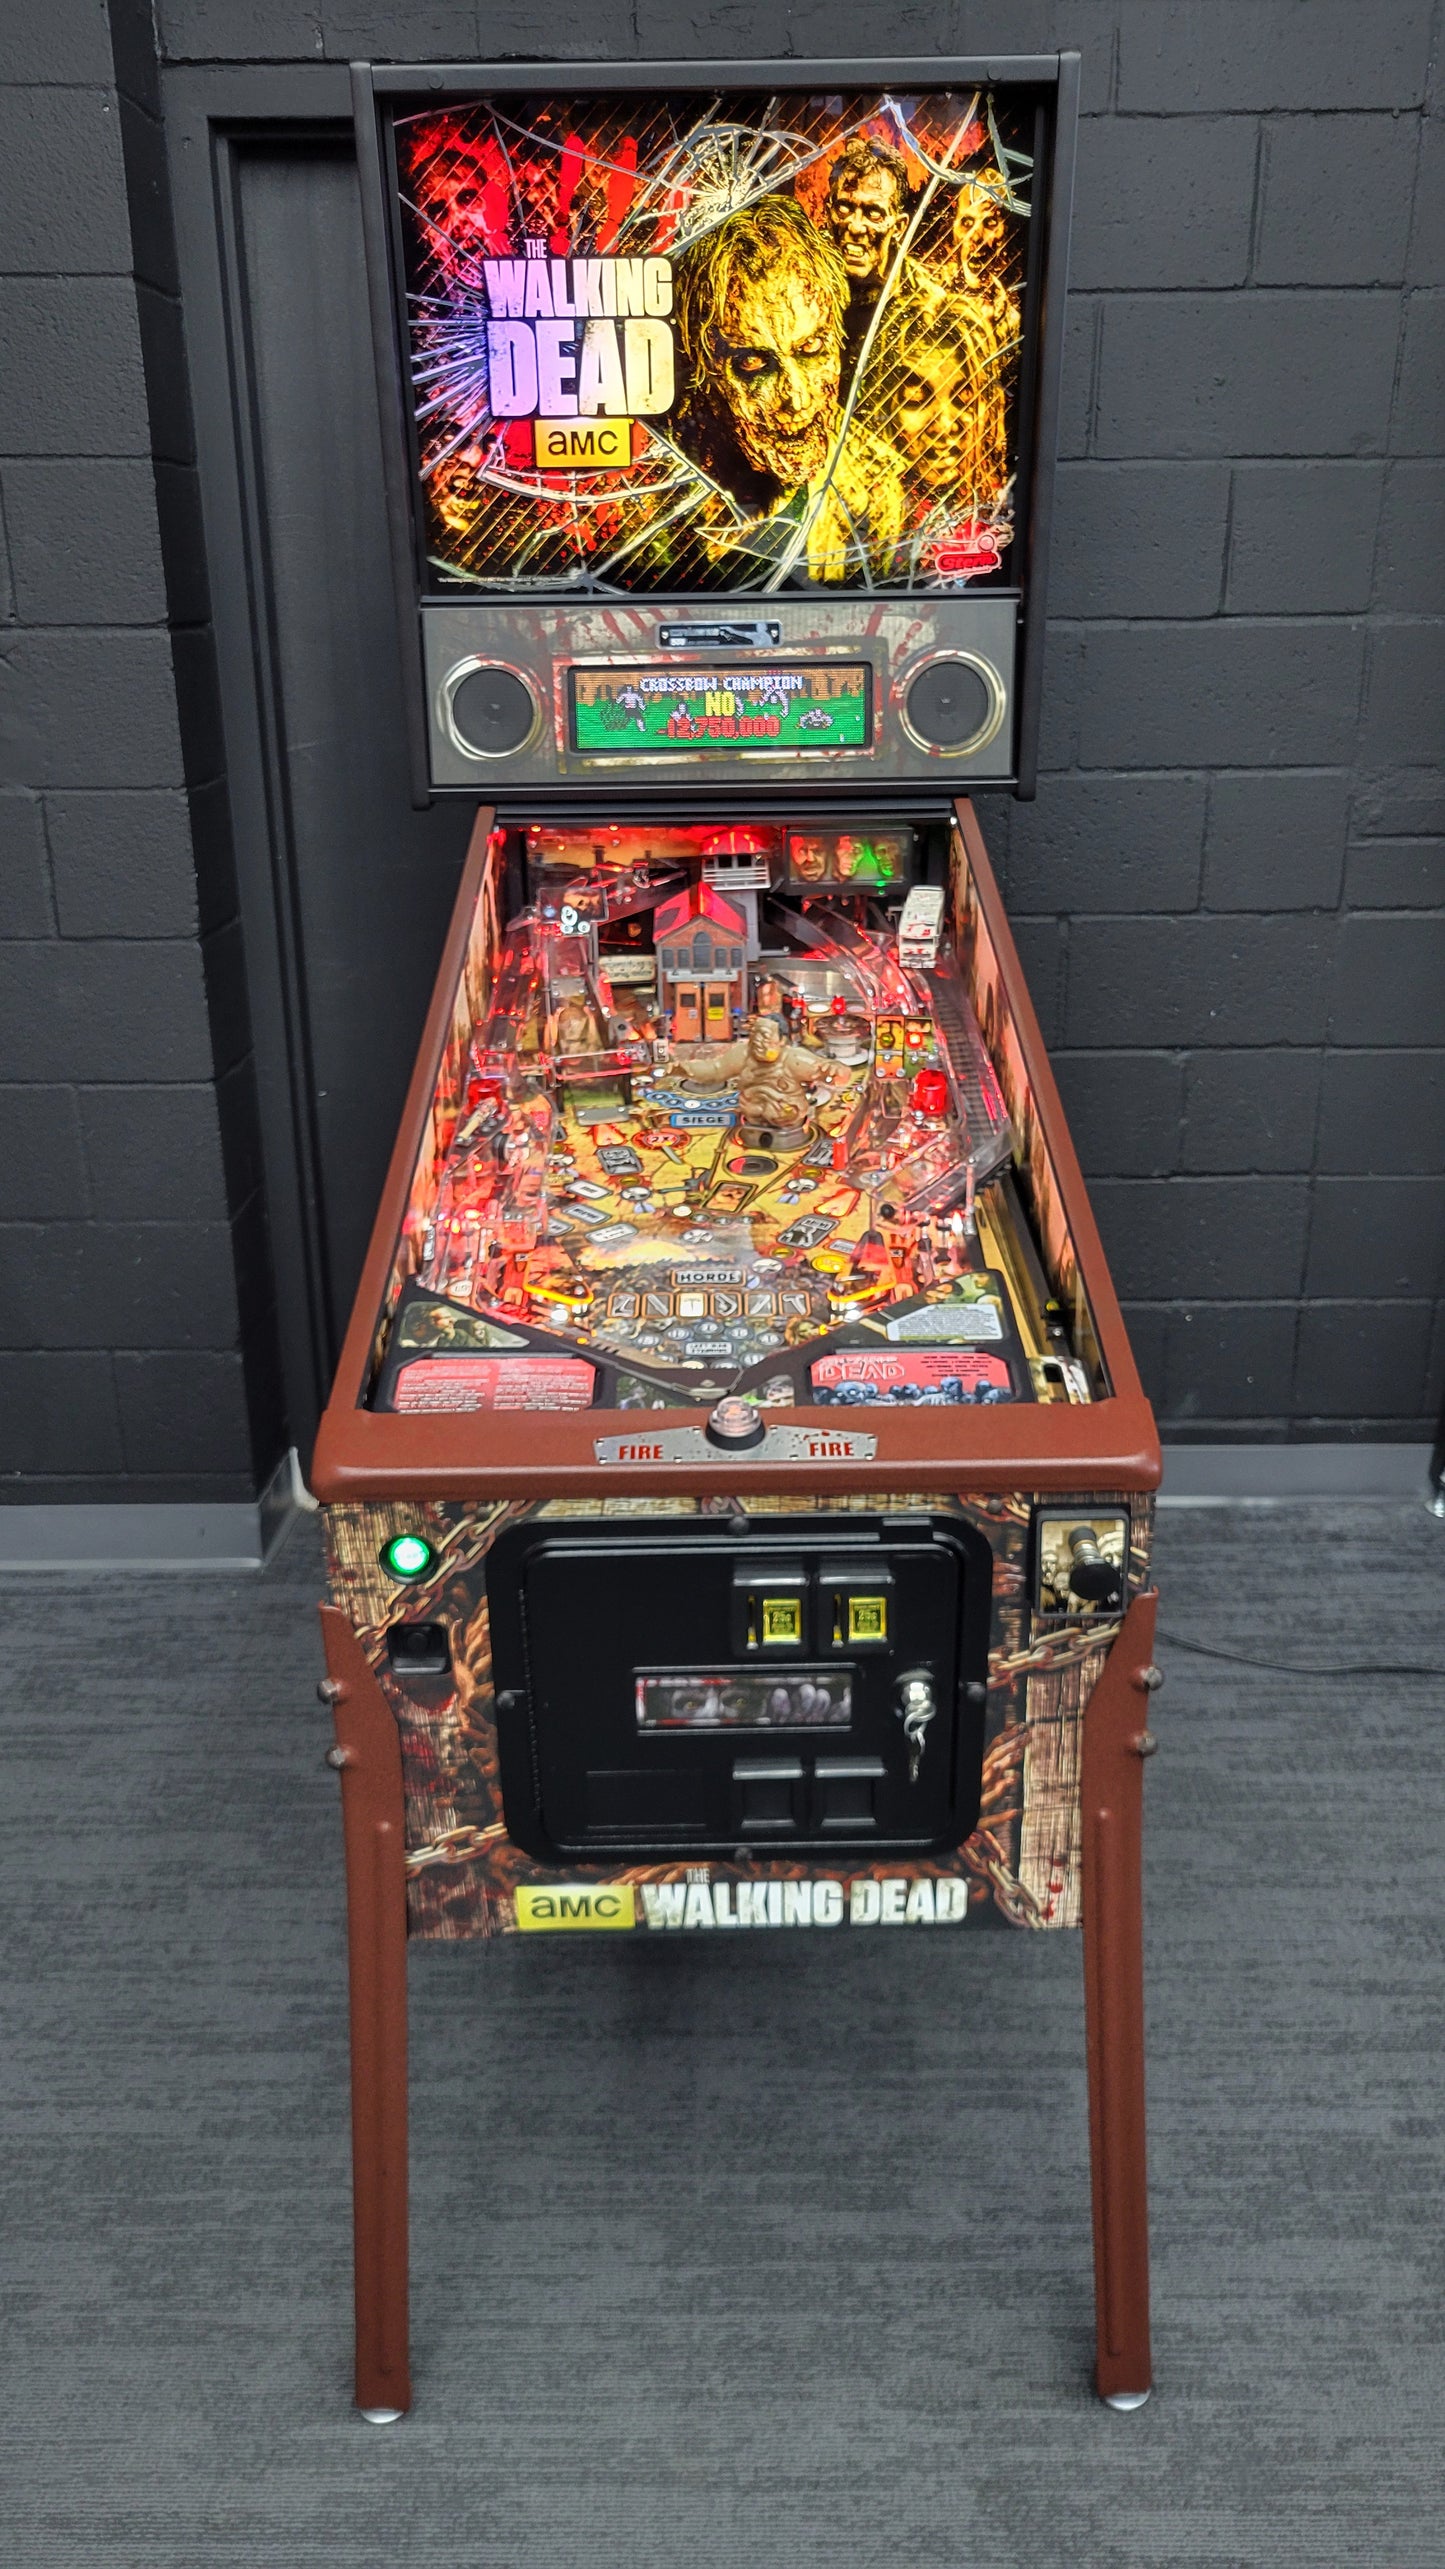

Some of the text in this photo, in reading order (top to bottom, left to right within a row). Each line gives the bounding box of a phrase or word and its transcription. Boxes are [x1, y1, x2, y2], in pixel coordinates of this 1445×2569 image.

[524, 239, 547, 258] THE
[483, 257, 673, 317] WALKING
[486, 319, 675, 416] DEAD
[640, 675, 803, 692] CROSSBOW CHAMPION
[705, 691, 735, 717] NO
[656, 716, 780, 740] -12,750,000
[682, 1116, 725, 1124] SIEGE
[680, 1273, 738, 1282] HORDE
[819, 1362, 905, 1381] DEAD
[618, 1442, 854, 1460] FIRE FIRE
[686, 1868, 710, 1884] THE
[641, 1879, 843, 1929] WALKING
[850, 1878, 968, 1925] DEAD
